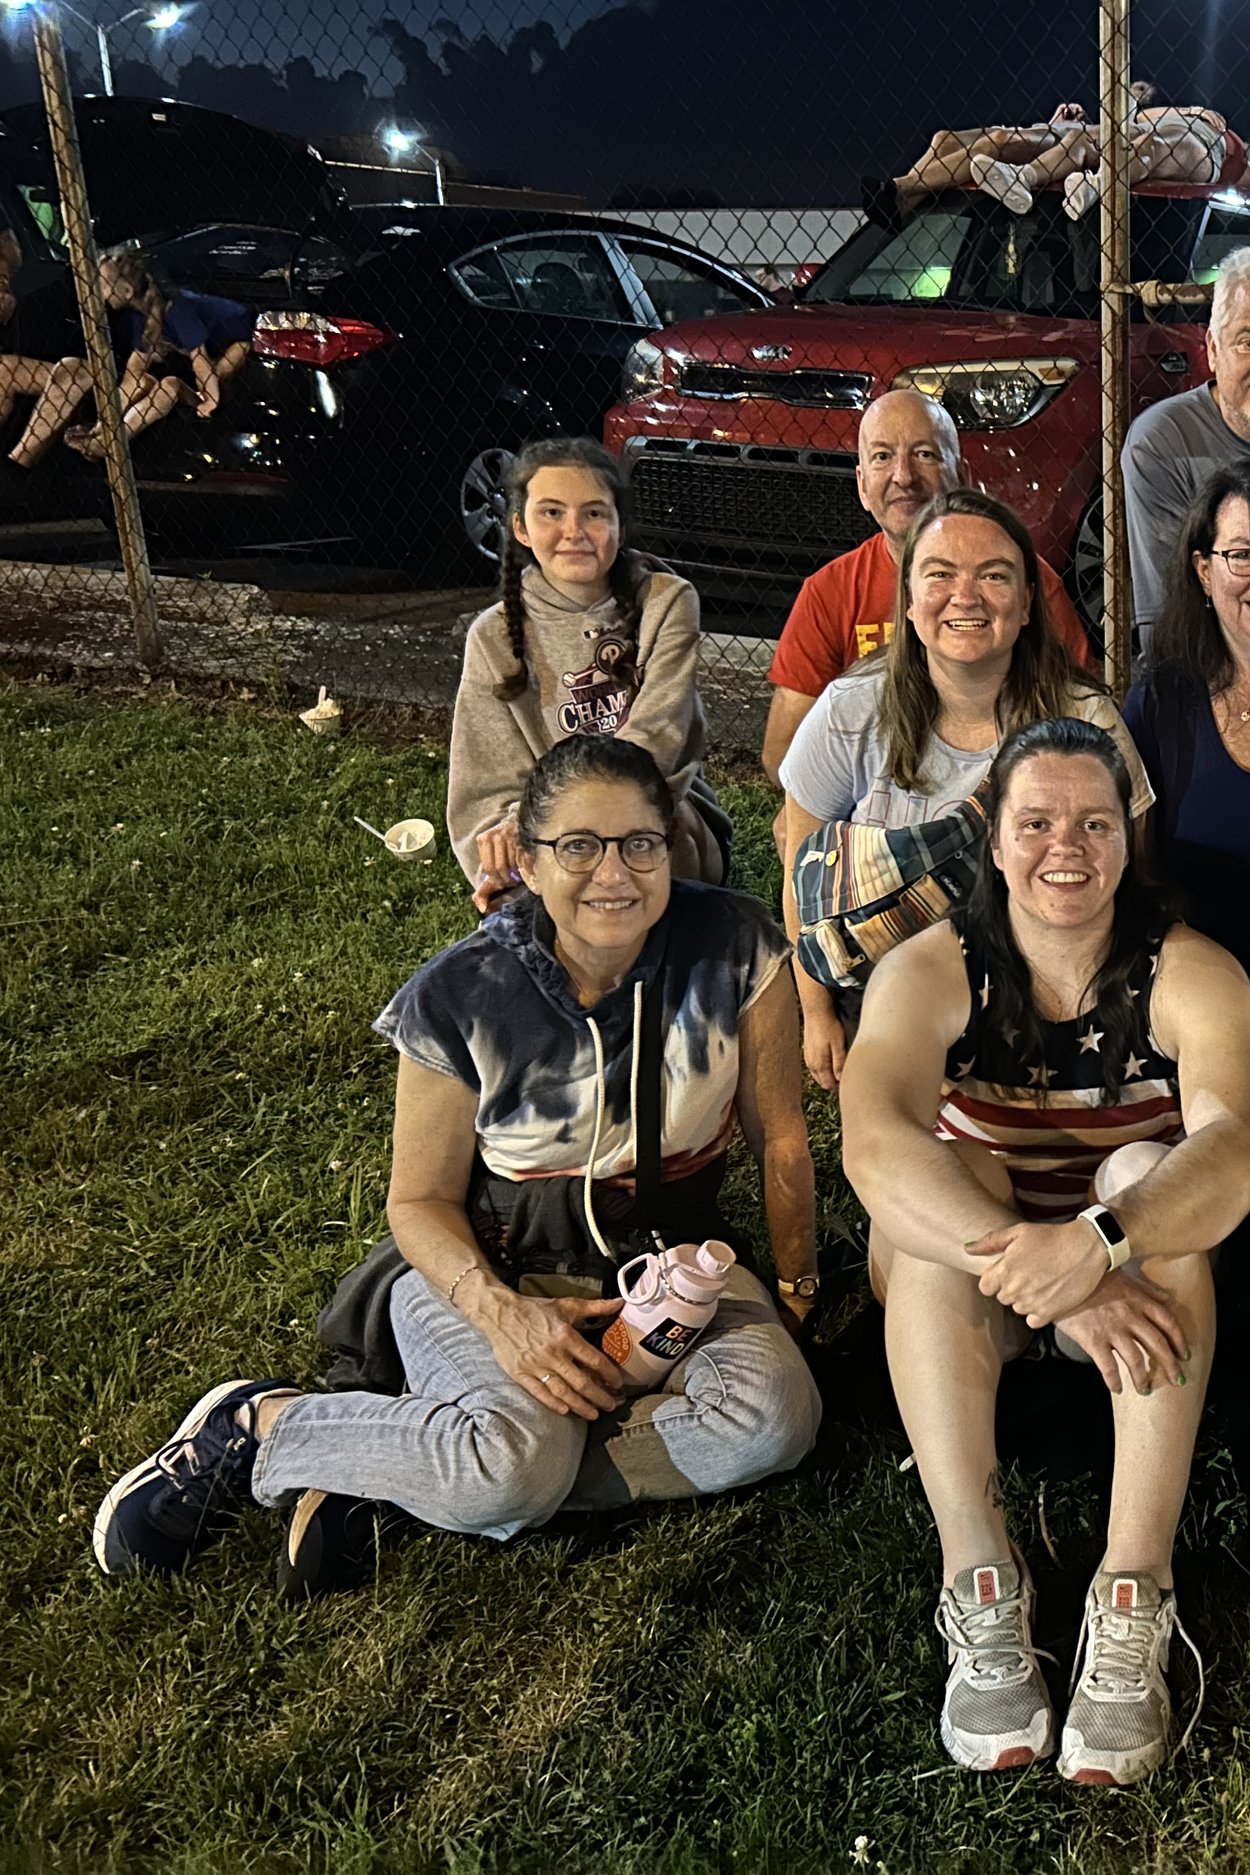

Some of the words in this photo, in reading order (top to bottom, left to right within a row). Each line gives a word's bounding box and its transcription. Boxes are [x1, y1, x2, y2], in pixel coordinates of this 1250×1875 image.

[558, 691, 628, 733] CHAM
[645, 1331, 685, 1356] KIND
[664, 1324, 693, 1342] BE
